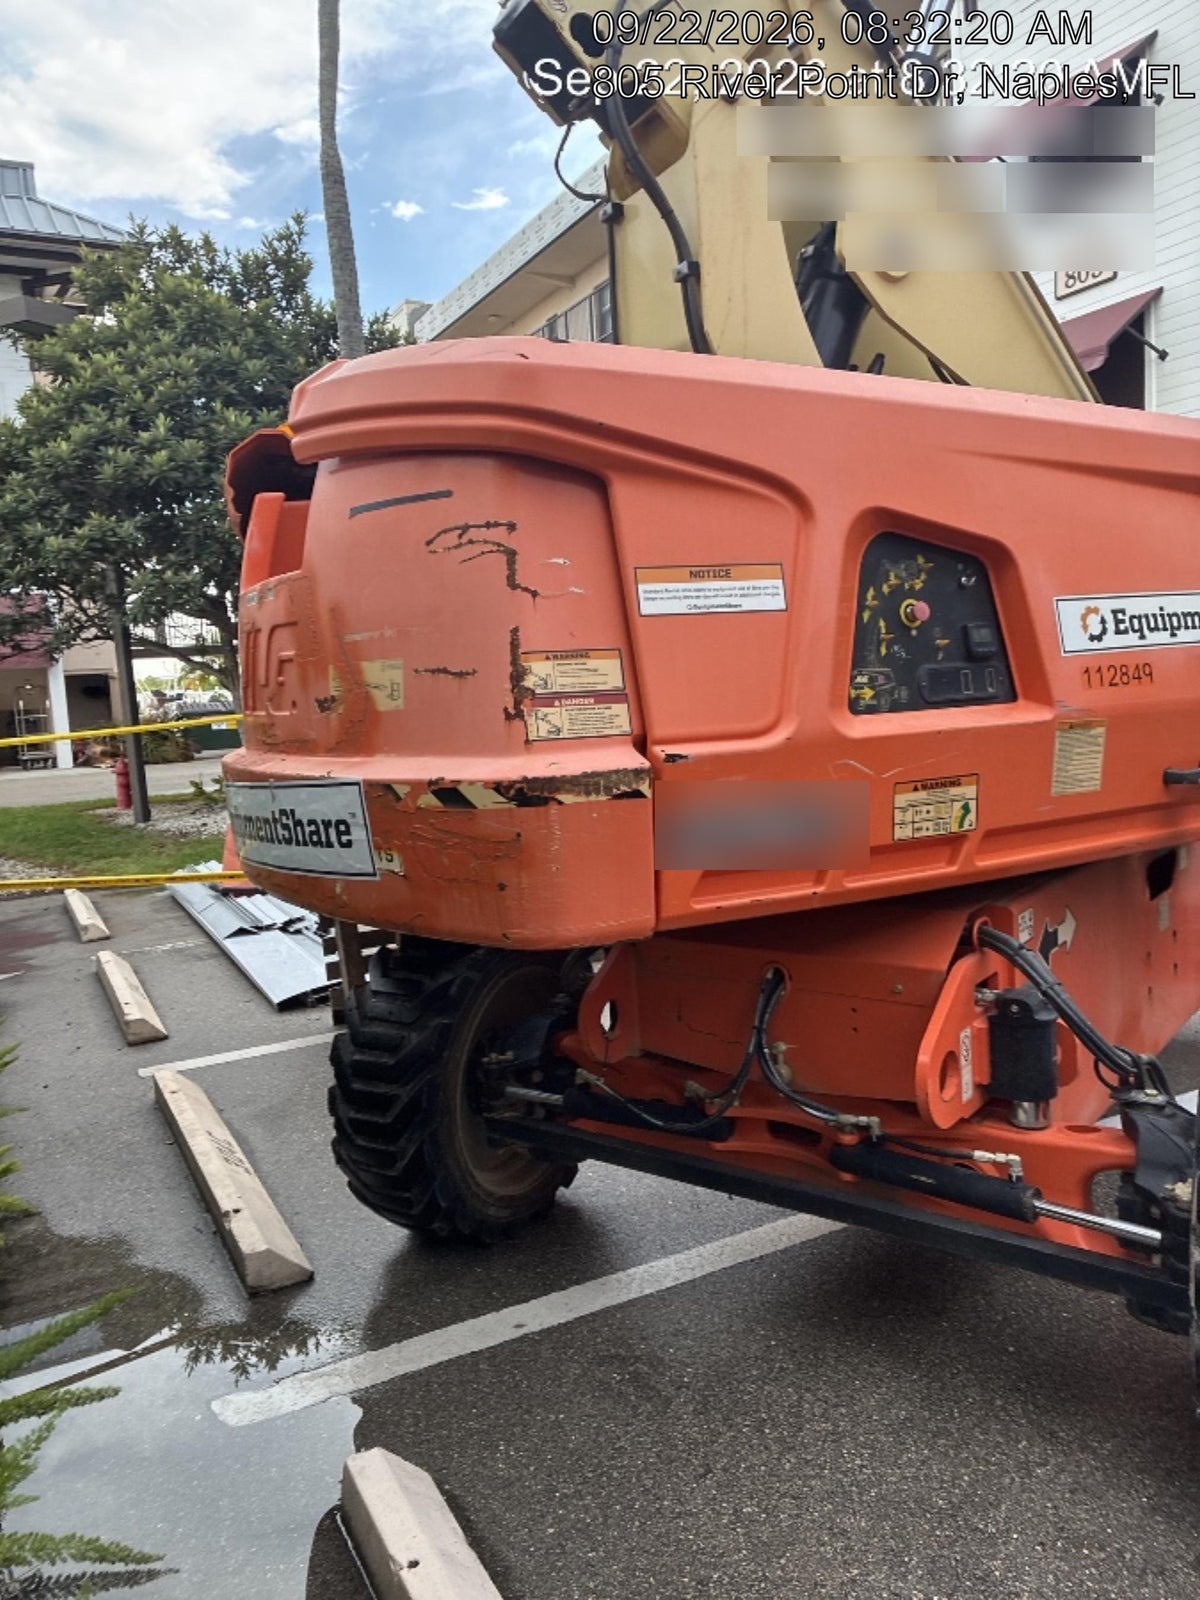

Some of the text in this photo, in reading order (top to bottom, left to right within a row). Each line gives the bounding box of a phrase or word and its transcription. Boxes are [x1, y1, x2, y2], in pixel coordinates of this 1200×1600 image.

[1064, 271, 1104, 289] 80
[689, 568, 732, 579] NOTICE
[1083, 662, 1154, 688] 112849
